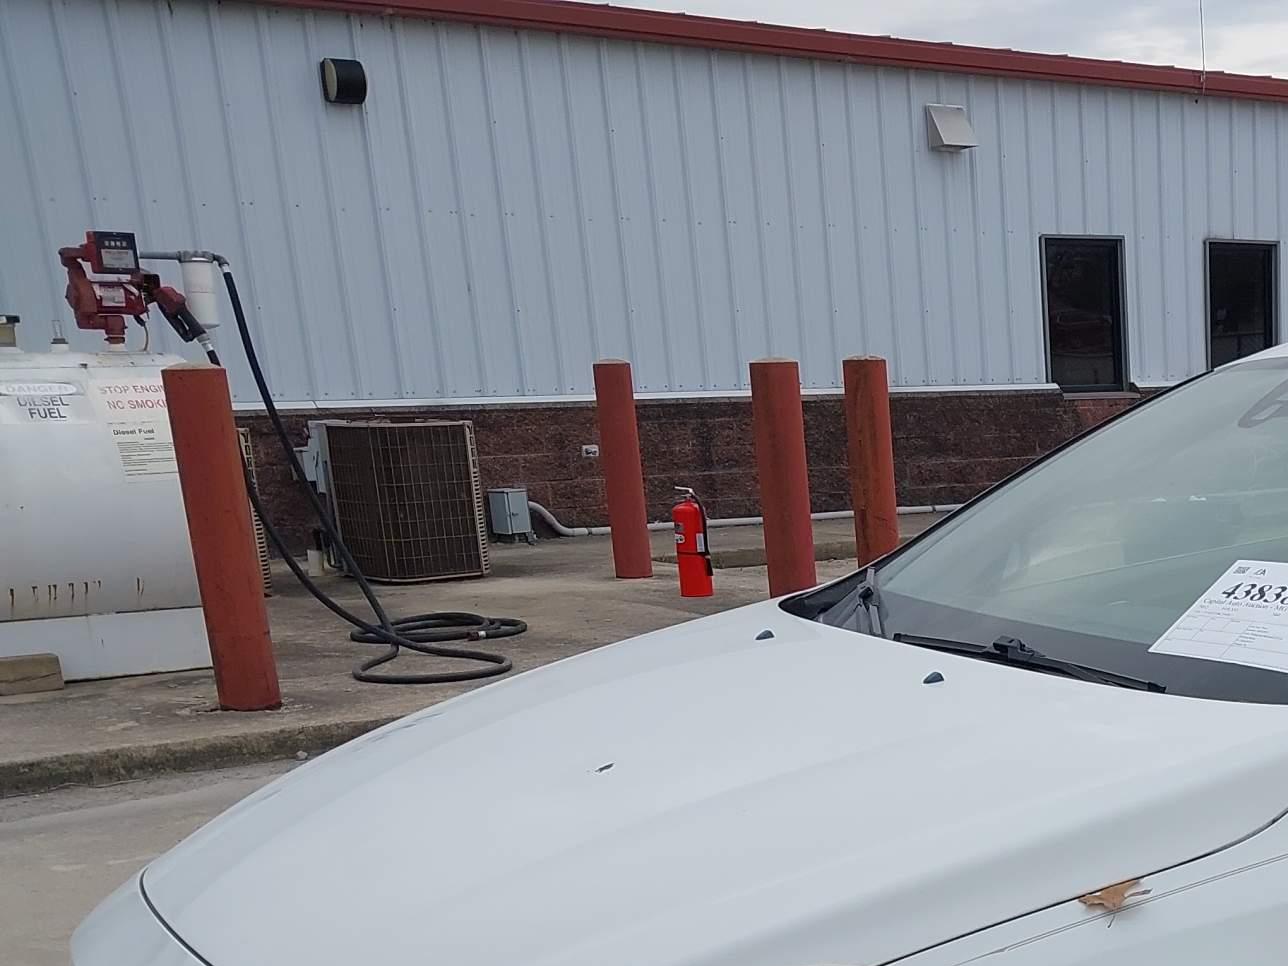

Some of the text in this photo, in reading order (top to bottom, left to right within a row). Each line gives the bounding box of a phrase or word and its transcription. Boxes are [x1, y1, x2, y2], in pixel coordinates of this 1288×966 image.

[98, 384, 164, 395] STOP ENGI
[17, 396, 70, 407] DIESEL
[28, 407, 67, 419] FUEL
[138, 427, 155, 435] Fuel
